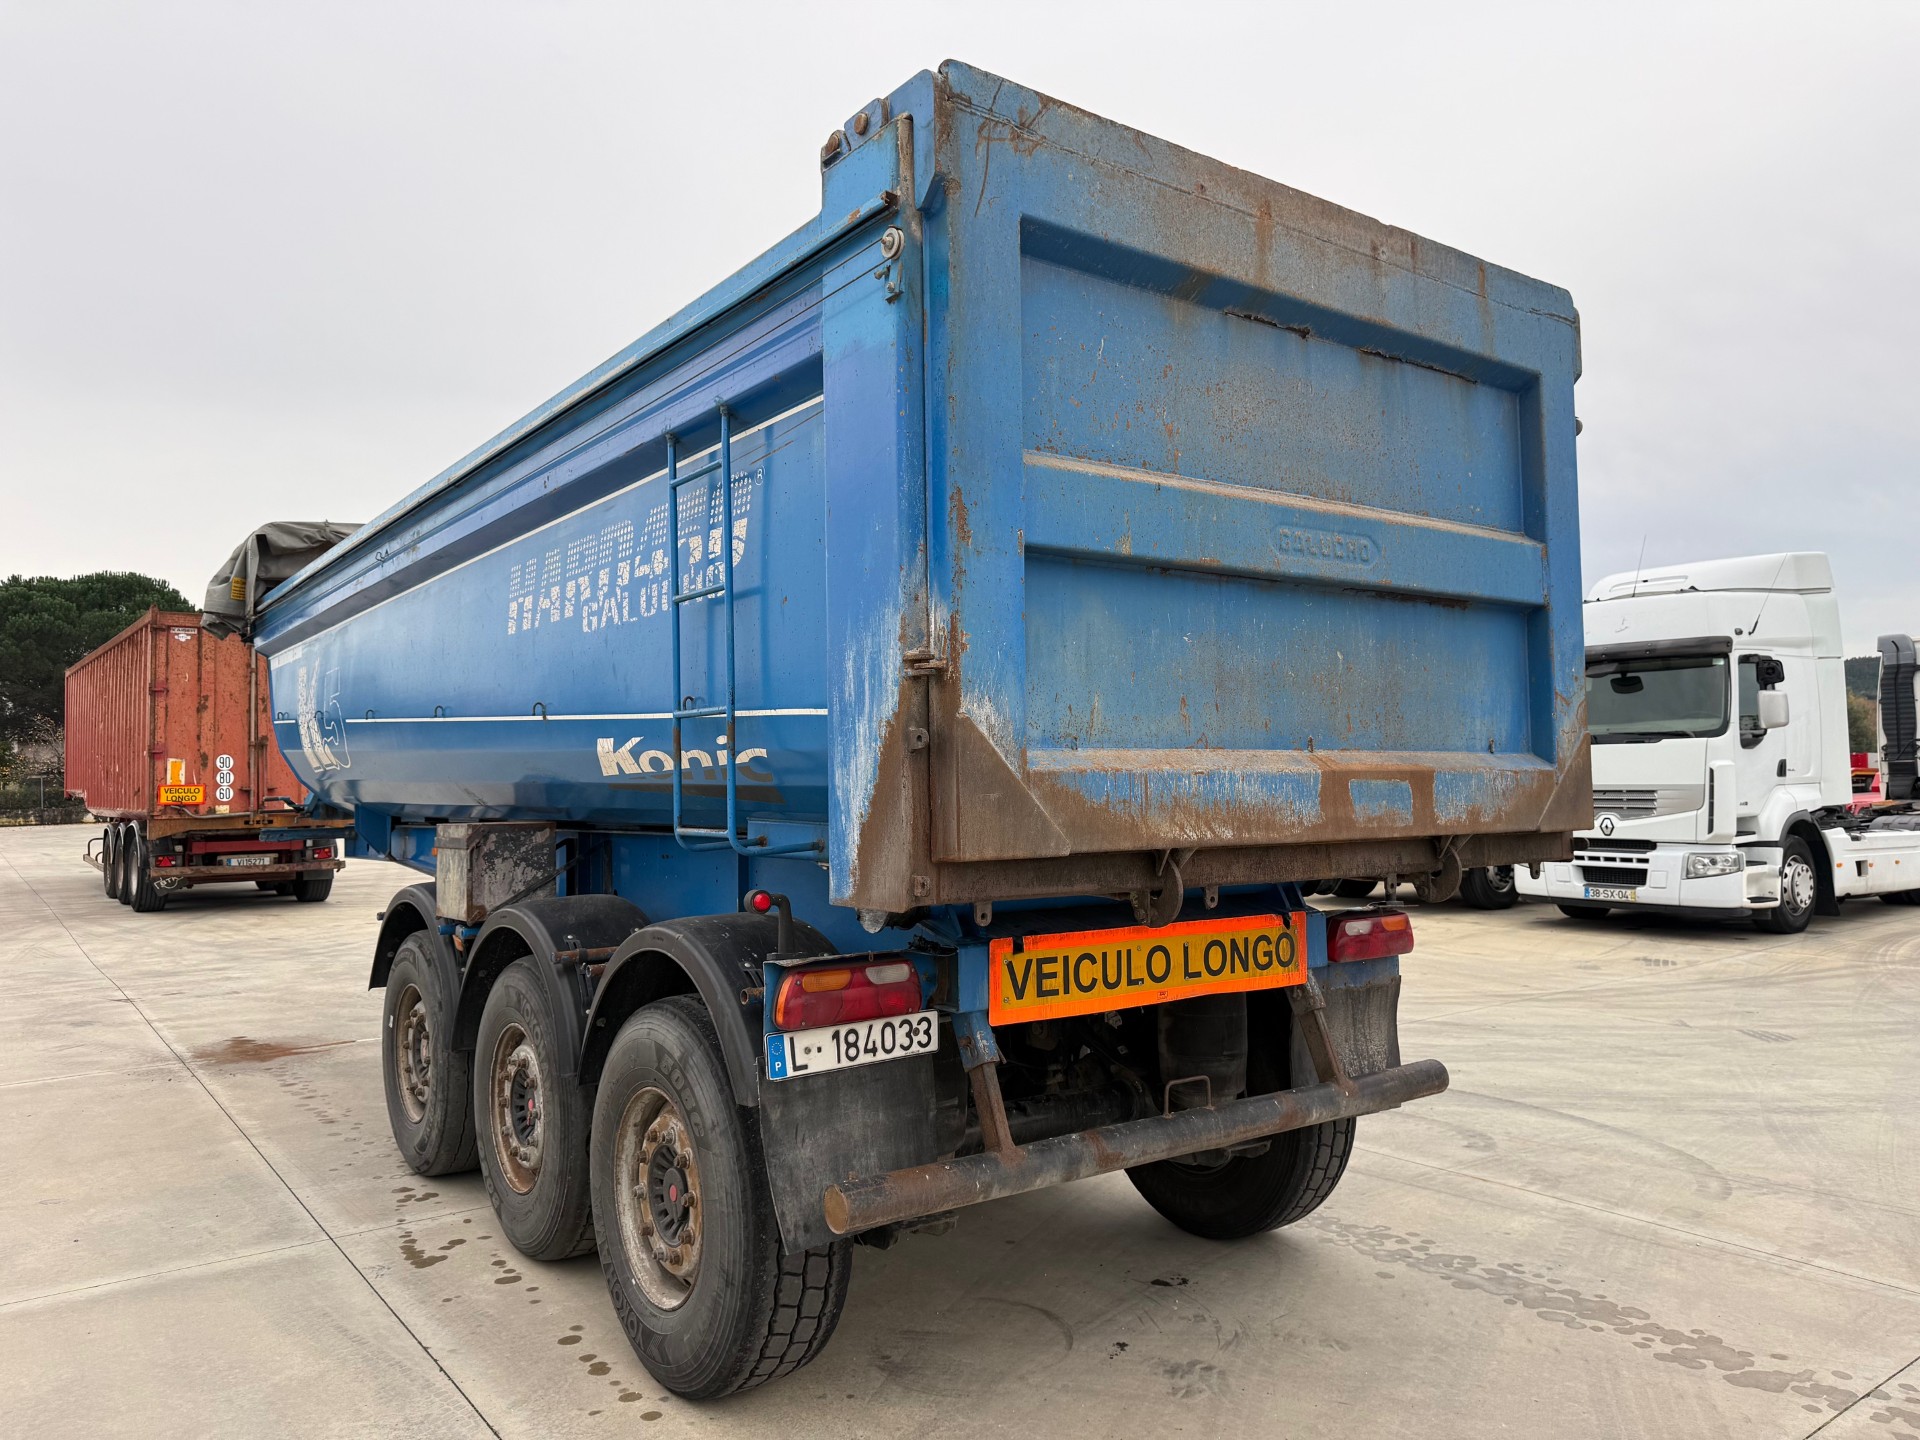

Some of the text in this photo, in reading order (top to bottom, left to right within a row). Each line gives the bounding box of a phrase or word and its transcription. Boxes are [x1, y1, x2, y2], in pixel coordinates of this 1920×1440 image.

[219, 756, 231, 768] 90
[596, 734, 773, 782] Konic
[219, 772, 231, 784] 80
[163, 787, 201, 795] VEICULO
[218, 787, 231, 800] 60
[1005, 931, 1296, 1001] VEICULO LONGO
[774, 1061, 782, 1072] P
